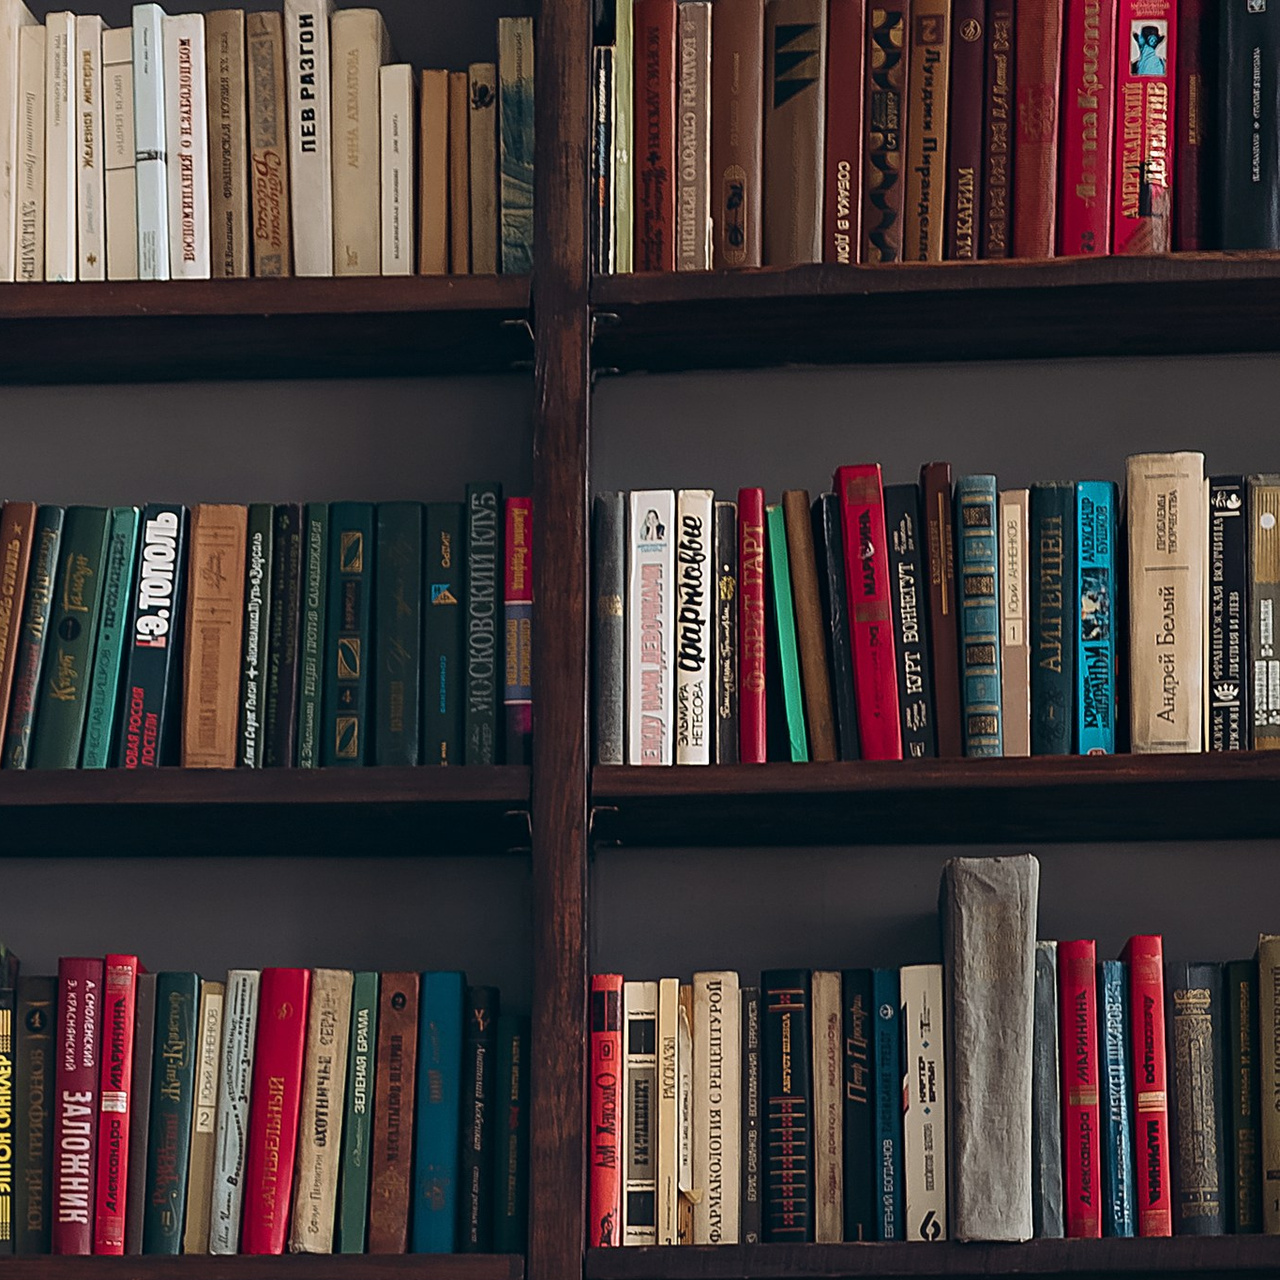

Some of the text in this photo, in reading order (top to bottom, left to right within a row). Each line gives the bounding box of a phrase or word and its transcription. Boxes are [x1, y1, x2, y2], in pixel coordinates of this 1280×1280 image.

[299, 14, 317, 153] ЛЕВ РАЗГОН
[1120, 82, 1143, 219] АМЕРИКАНСКИЙ
[1145, 82, 1168, 188] ДЕТЕКТИВ
[467, 491, 496, 716] МОСКОВСКИЙ КЛУБ
[898, 561, 923, 695] КУРТ ВОННЕГУТ
[1157, 585, 1180, 724] Андрей Белый
[128, 686, 145, 734] РОССИЯ
[141, 712, 159, 766] ПОСТЕЛИ
[677, 683, 689, 748] ЭЛЬМИРА
[691, 679, 704, 747] НЕТЕСОВА
[103, 996, 127, 1214] Александра МАРИНИНА
[354, 1008, 370, 1116] ЗЕЛЕНАЯ БРАМА
[705, 980, 723, 1245] ФАРМАКОЛОГИЯ С РЕЦЕПТУРОЙ
[1075, 990, 1094, 1208] Александра МАРИНИНА
[23, 1049, 49, 1232] ЮРИЙ ТРИФОНОВ
[58, 1090, 93, 1224] ЗАЛОЖНИК
[881, 1138, 894, 1239] ЕВГЕНИЙ БОГДАНОВ
